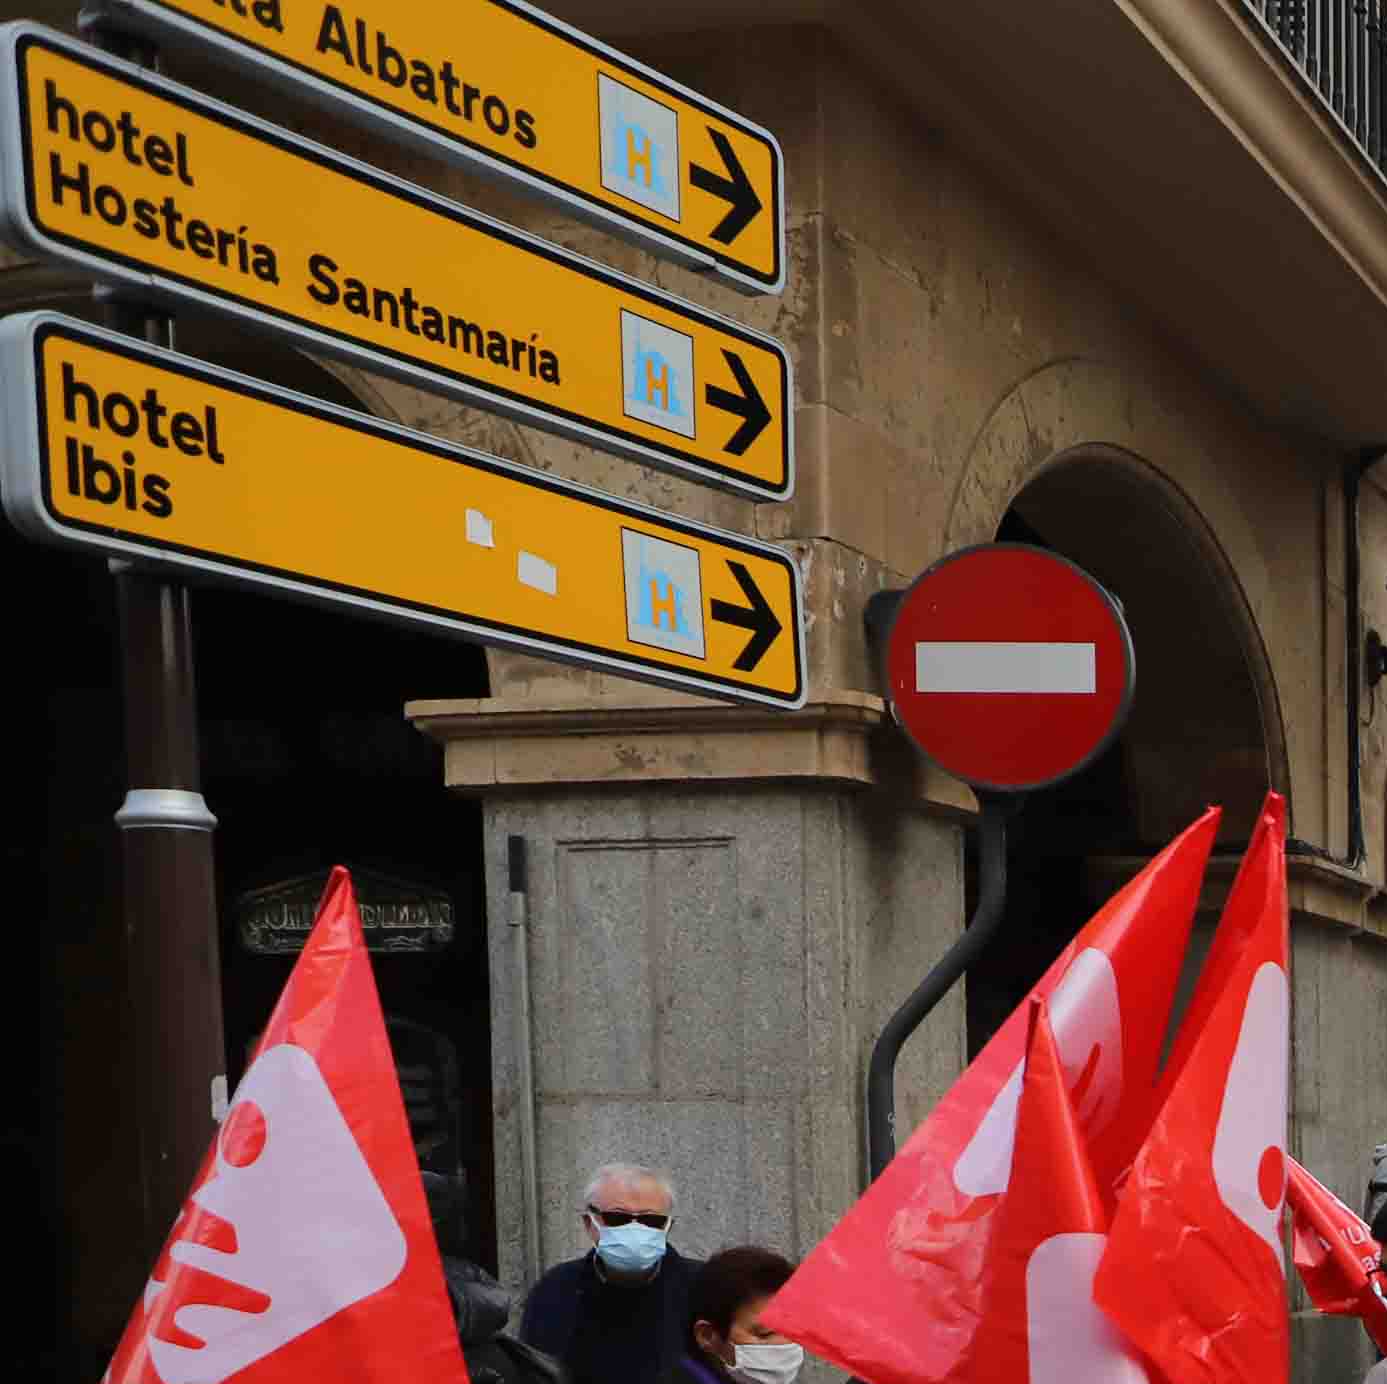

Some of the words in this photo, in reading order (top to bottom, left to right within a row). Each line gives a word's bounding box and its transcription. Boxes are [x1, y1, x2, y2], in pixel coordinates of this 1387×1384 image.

[316, 5, 536, 149] Albatros
[44, 80, 195, 187] hotel
[50, 153, 280, 285] Hostería
[306, 254, 562, 387] Santamaría
[61, 362, 225, 465] hotel
[66, 437, 174, 519] Ibis
